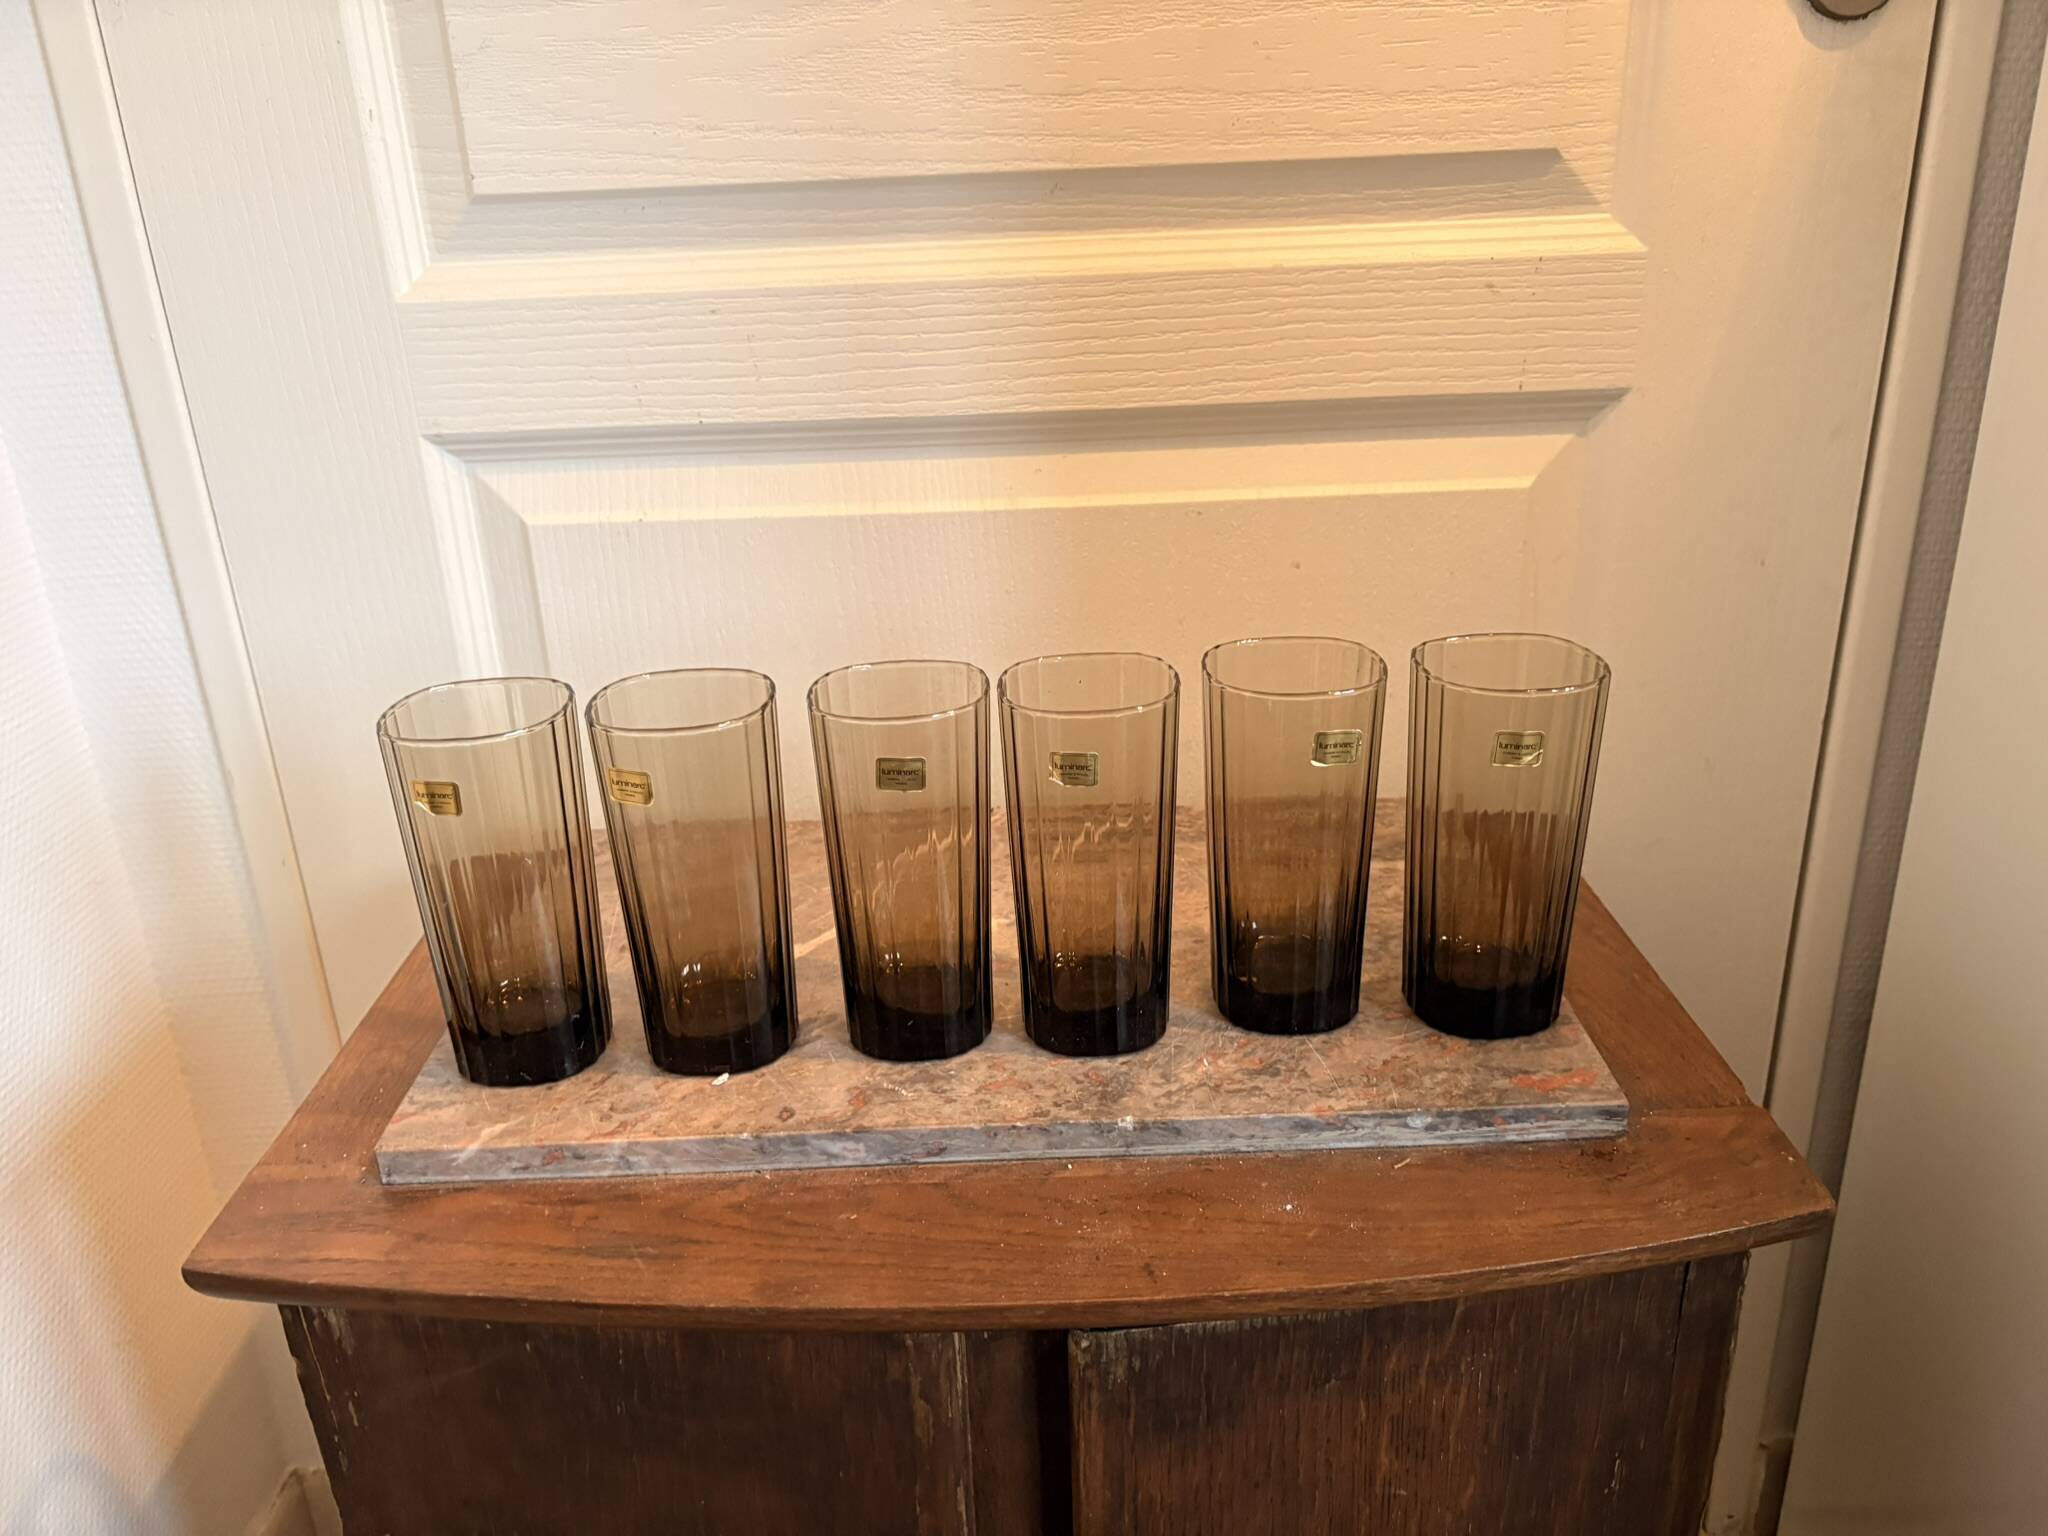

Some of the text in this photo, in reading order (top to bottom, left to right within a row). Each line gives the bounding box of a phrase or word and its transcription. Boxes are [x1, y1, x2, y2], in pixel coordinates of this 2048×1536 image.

[1499, 741, 1537, 750] luminarc
[1054, 762, 1093, 771] luminarc
[881, 767, 920, 776] luminarc
